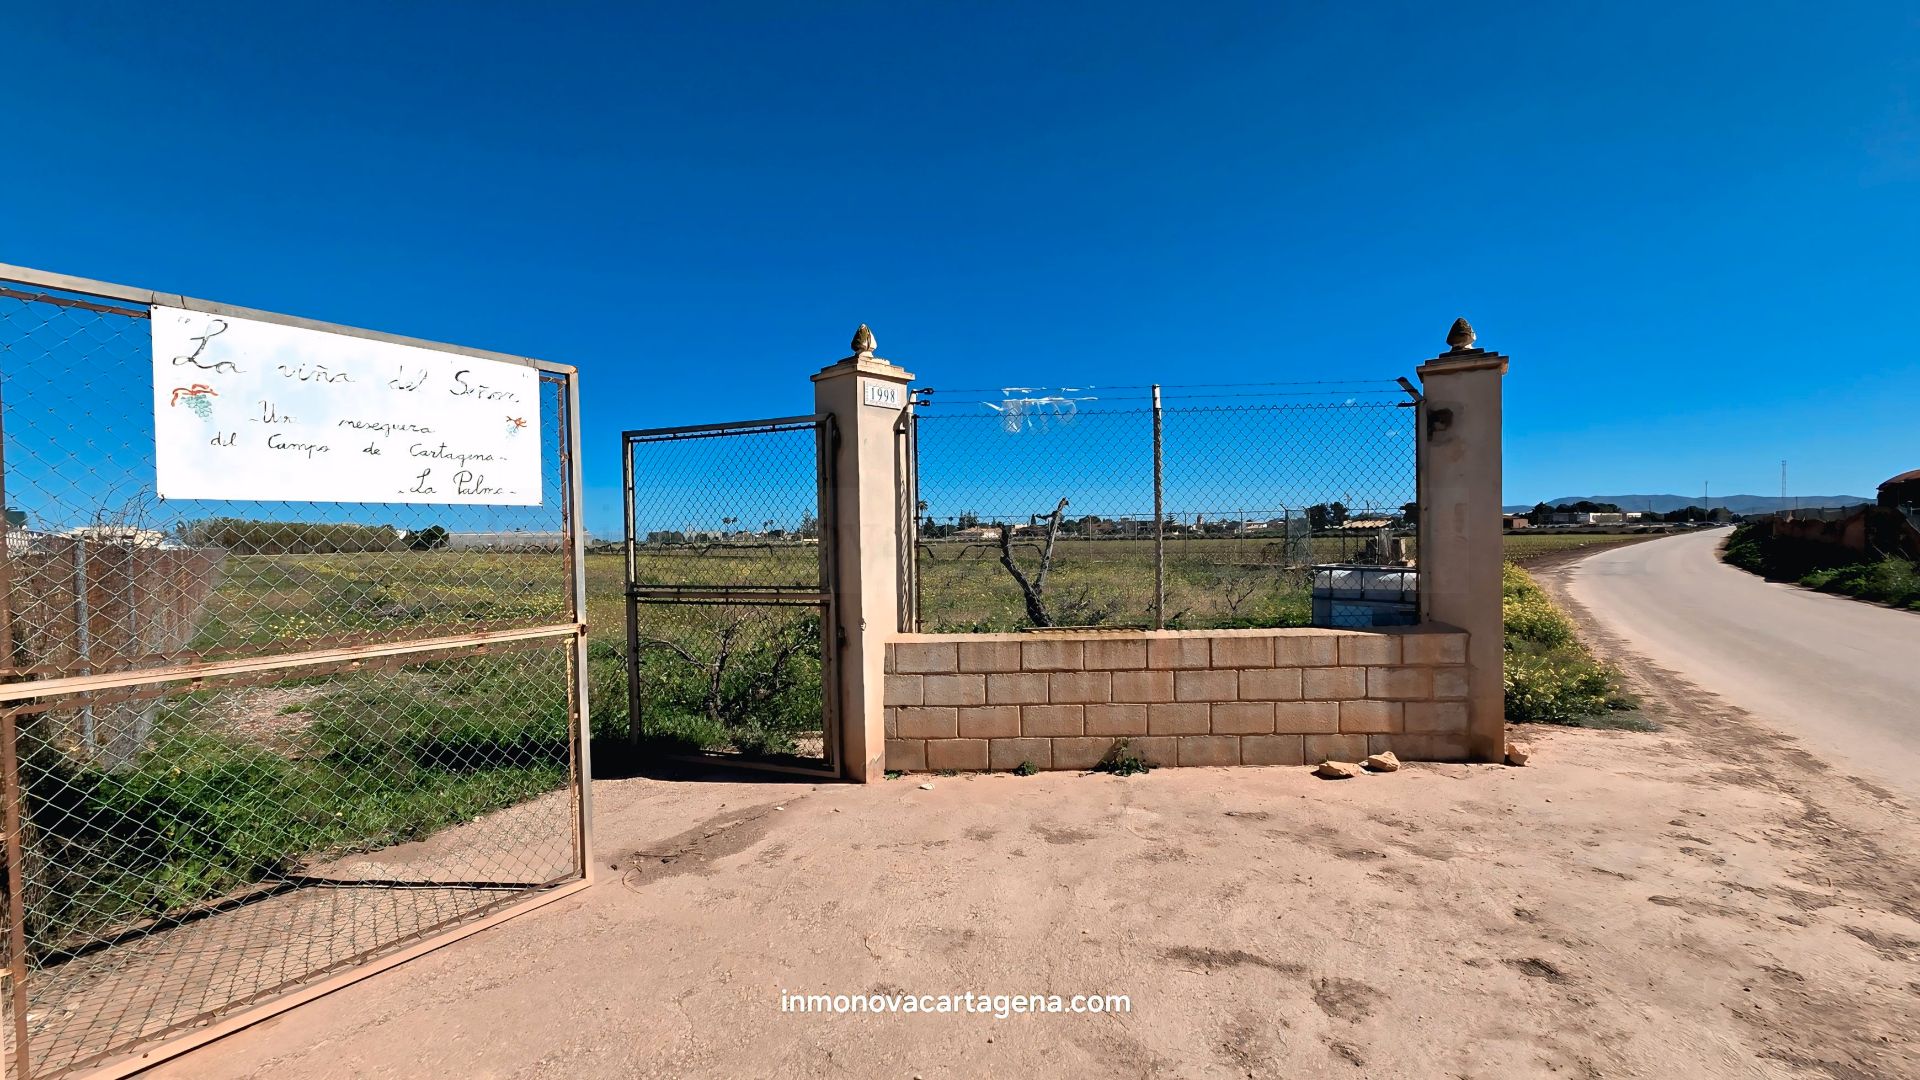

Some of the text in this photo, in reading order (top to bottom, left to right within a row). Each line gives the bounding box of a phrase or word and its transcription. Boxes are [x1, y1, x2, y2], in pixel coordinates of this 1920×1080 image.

[278, 363, 355, 382] viña
[871, 387, 895, 403] 1998
[211, 431, 237, 447] del
[363, 441, 381, 455] de
